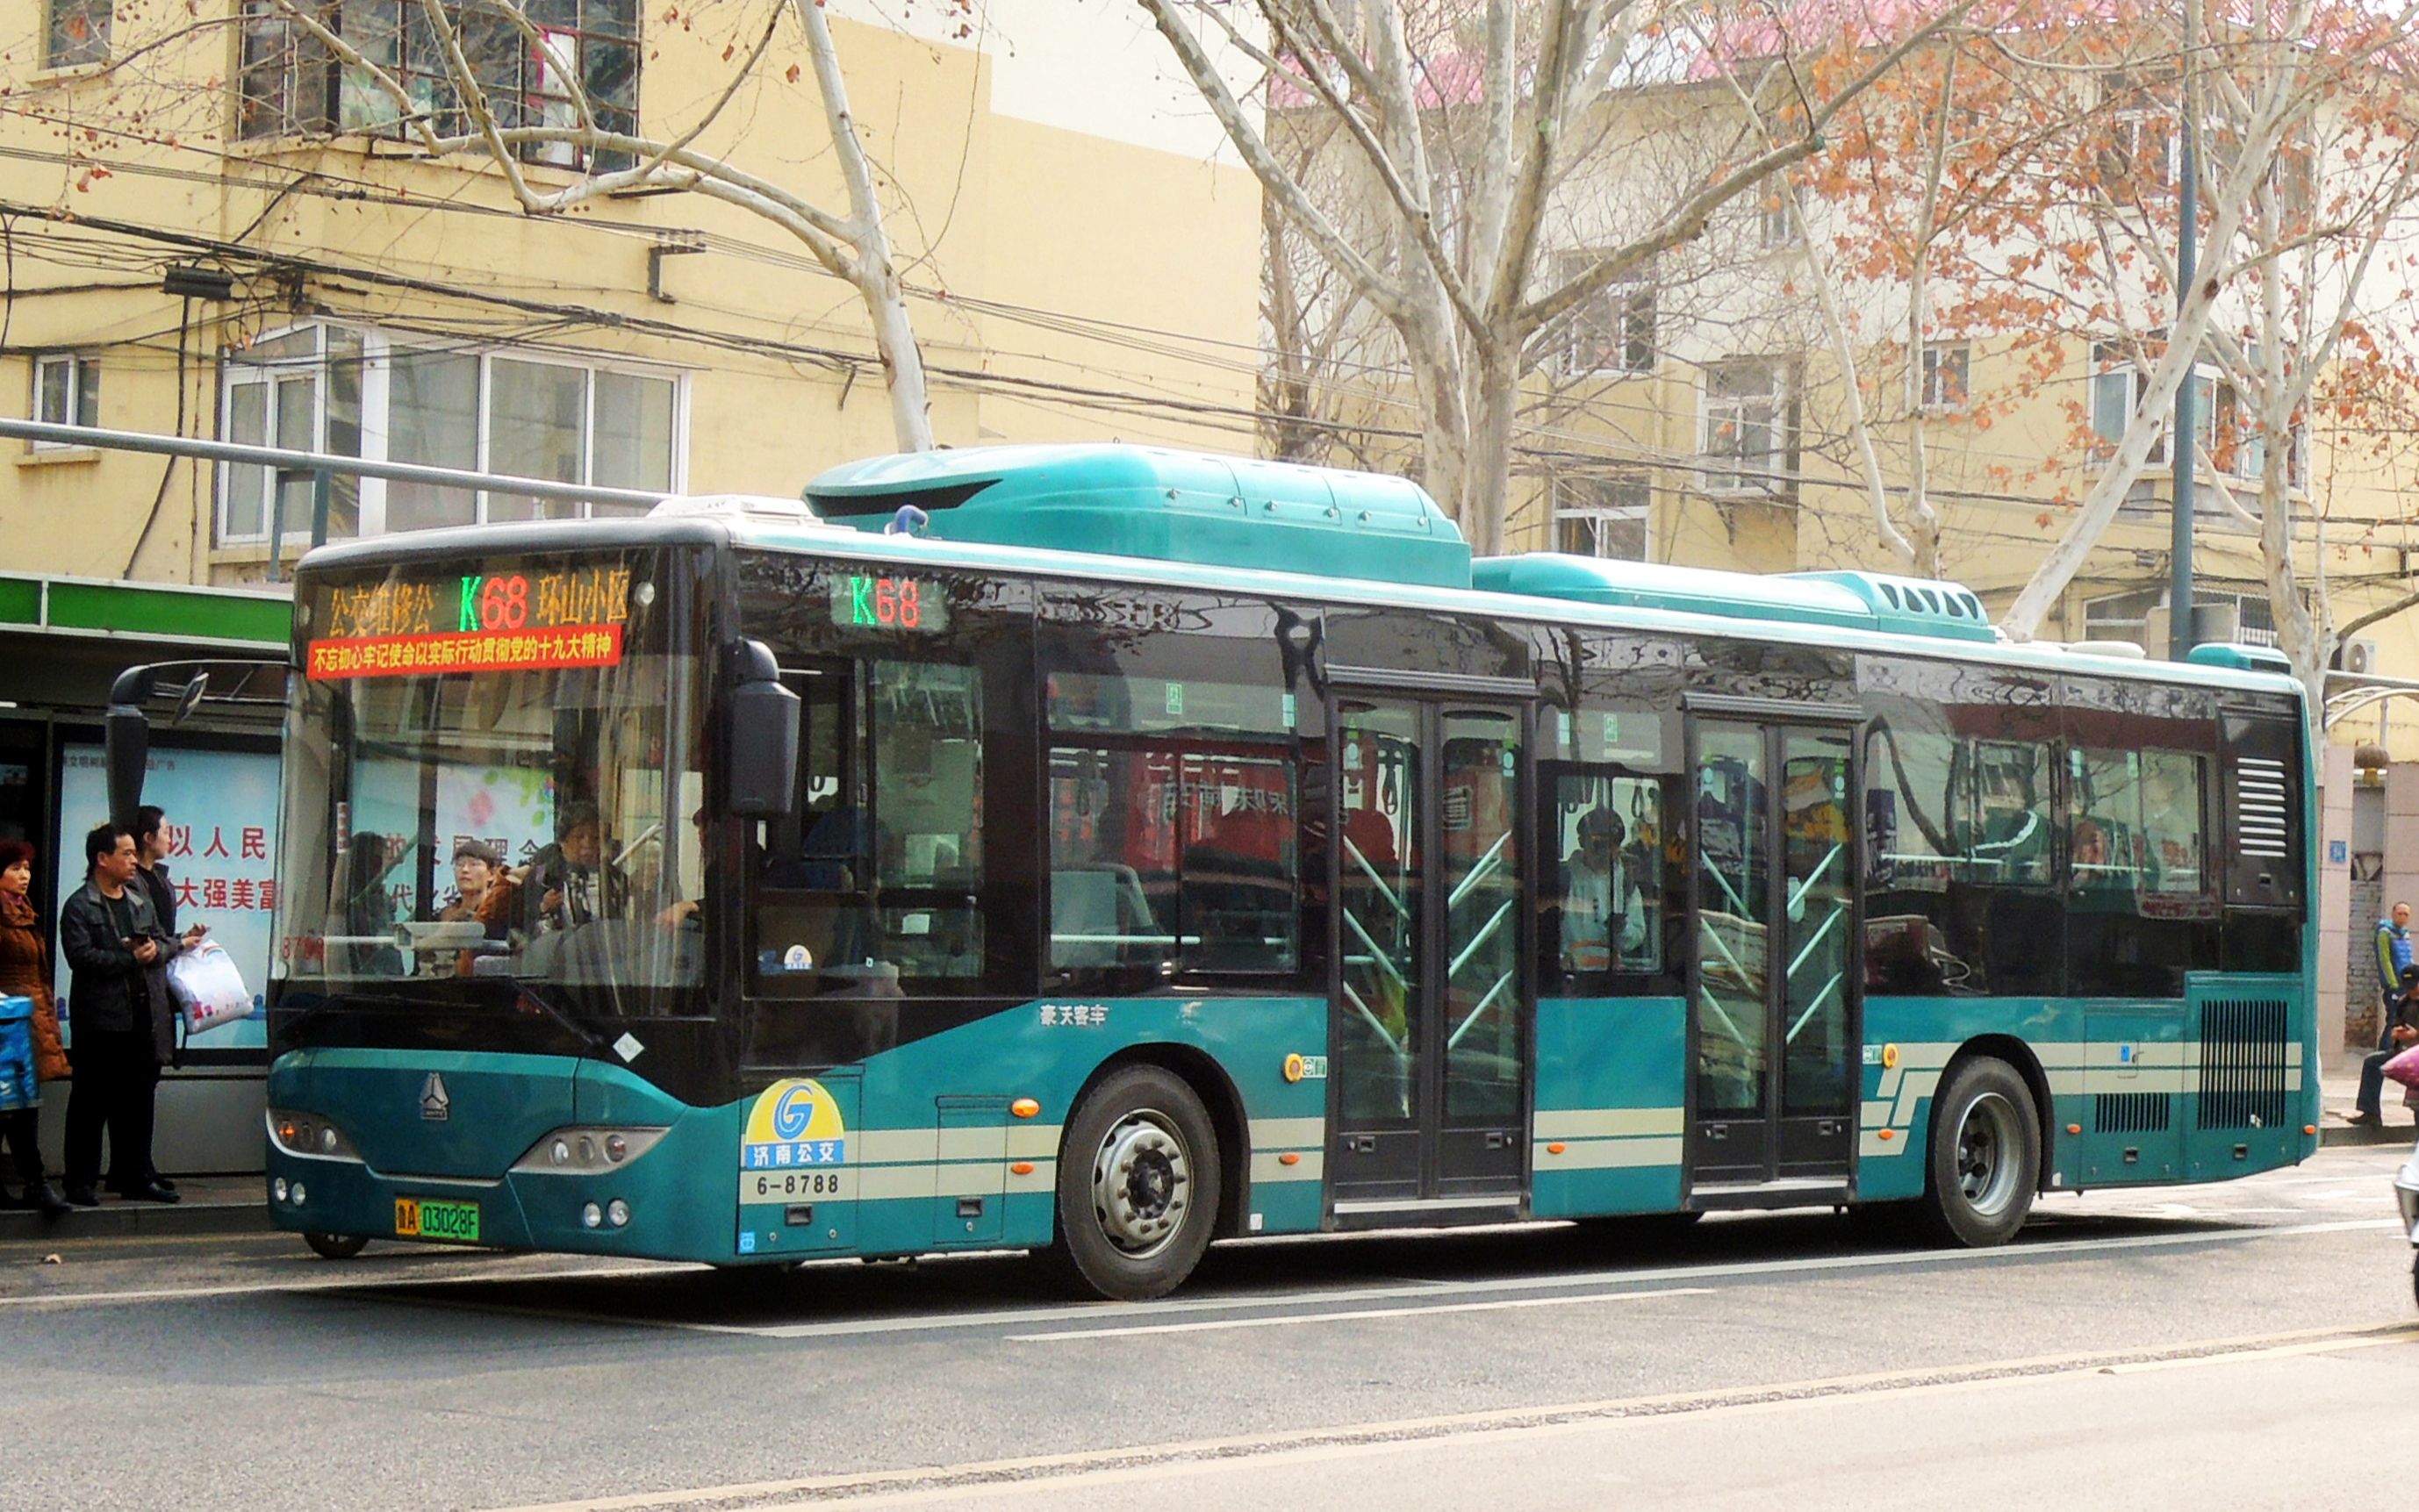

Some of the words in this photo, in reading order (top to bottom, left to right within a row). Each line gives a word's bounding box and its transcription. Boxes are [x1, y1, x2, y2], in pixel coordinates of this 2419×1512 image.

[458, 574, 529, 633] K68
[535, 569, 631, 627] 环山小区
[850, 575, 920, 629] K68
[313, 630, 614, 674] 不忘初心牢记使命以实际行动贯彻党的十九大精神
[166, 824, 267, 861] 以人民
[753, 1142, 835, 1168] 济南公交
[757, 1174, 839, 1195] 6-8788
